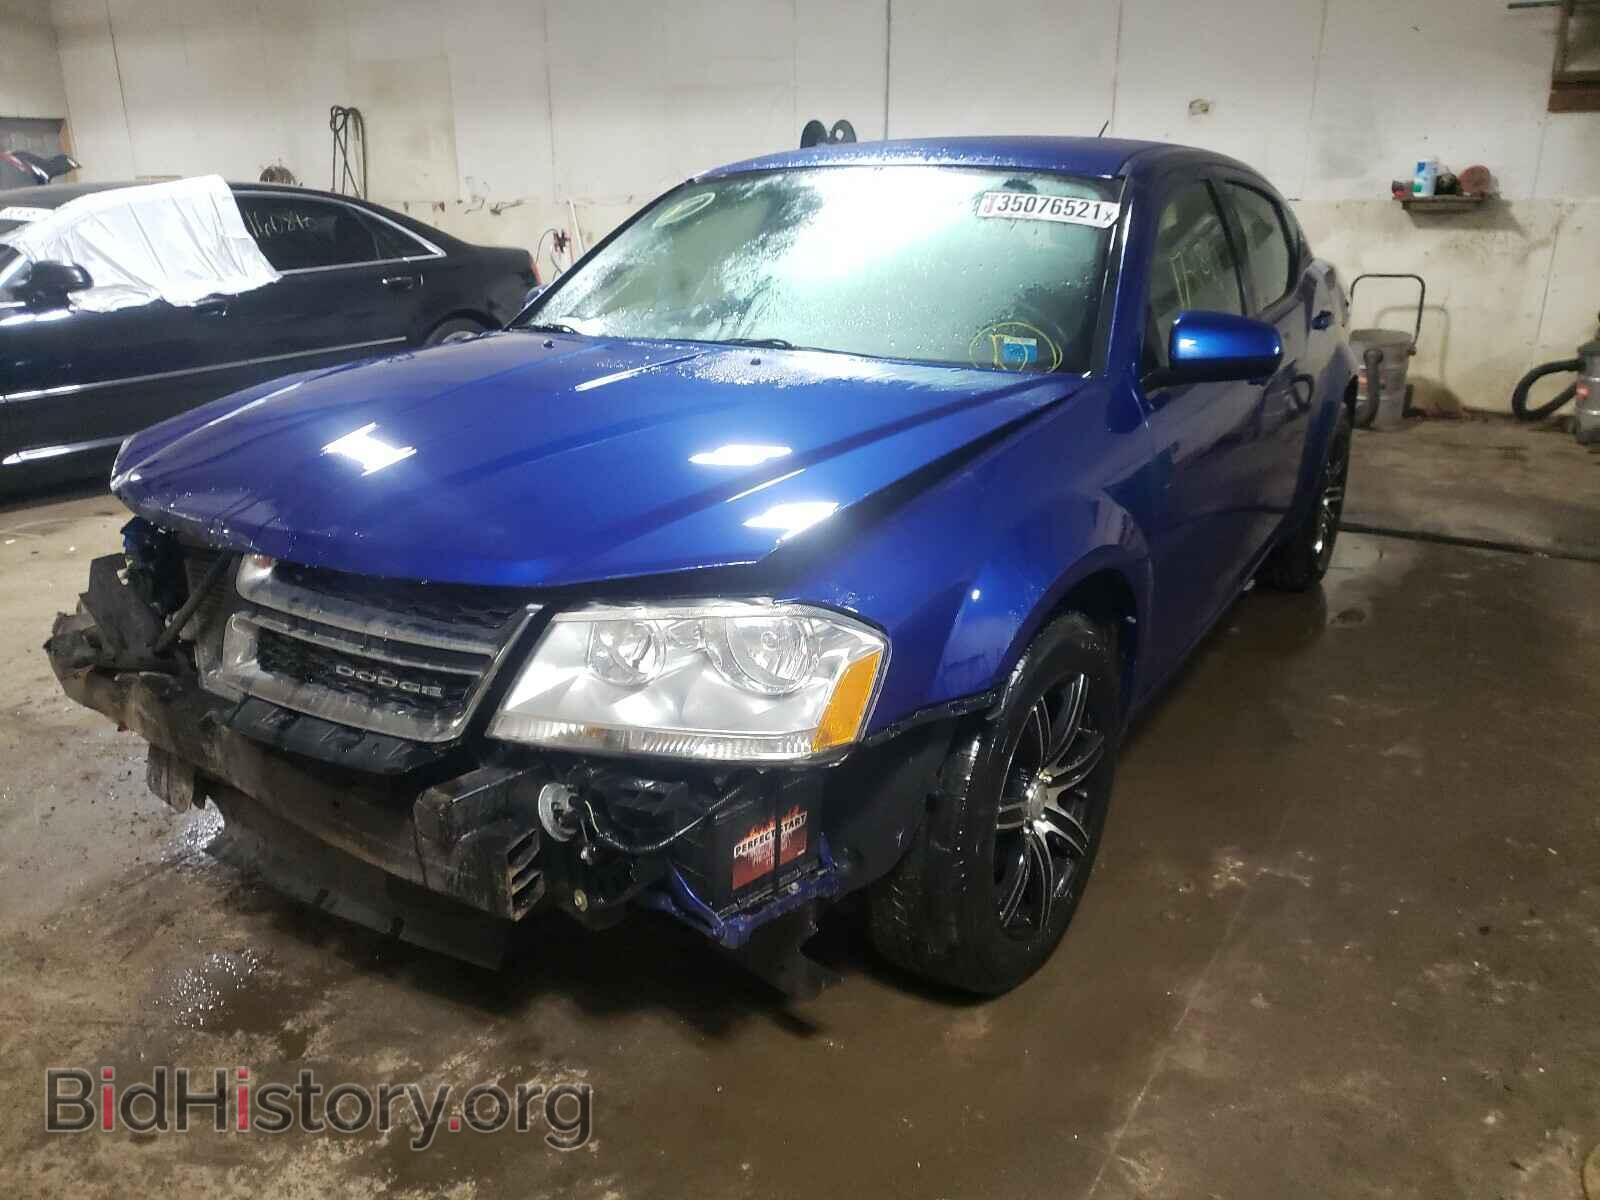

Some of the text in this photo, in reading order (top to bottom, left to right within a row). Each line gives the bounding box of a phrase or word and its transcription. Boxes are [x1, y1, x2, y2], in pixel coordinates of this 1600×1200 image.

[998, 194, 1100, 220] 35076521
[335, 665, 442, 697] DODGE
[735, 830, 777, 857] PERFECT
[780, 813, 807, 833] TART
